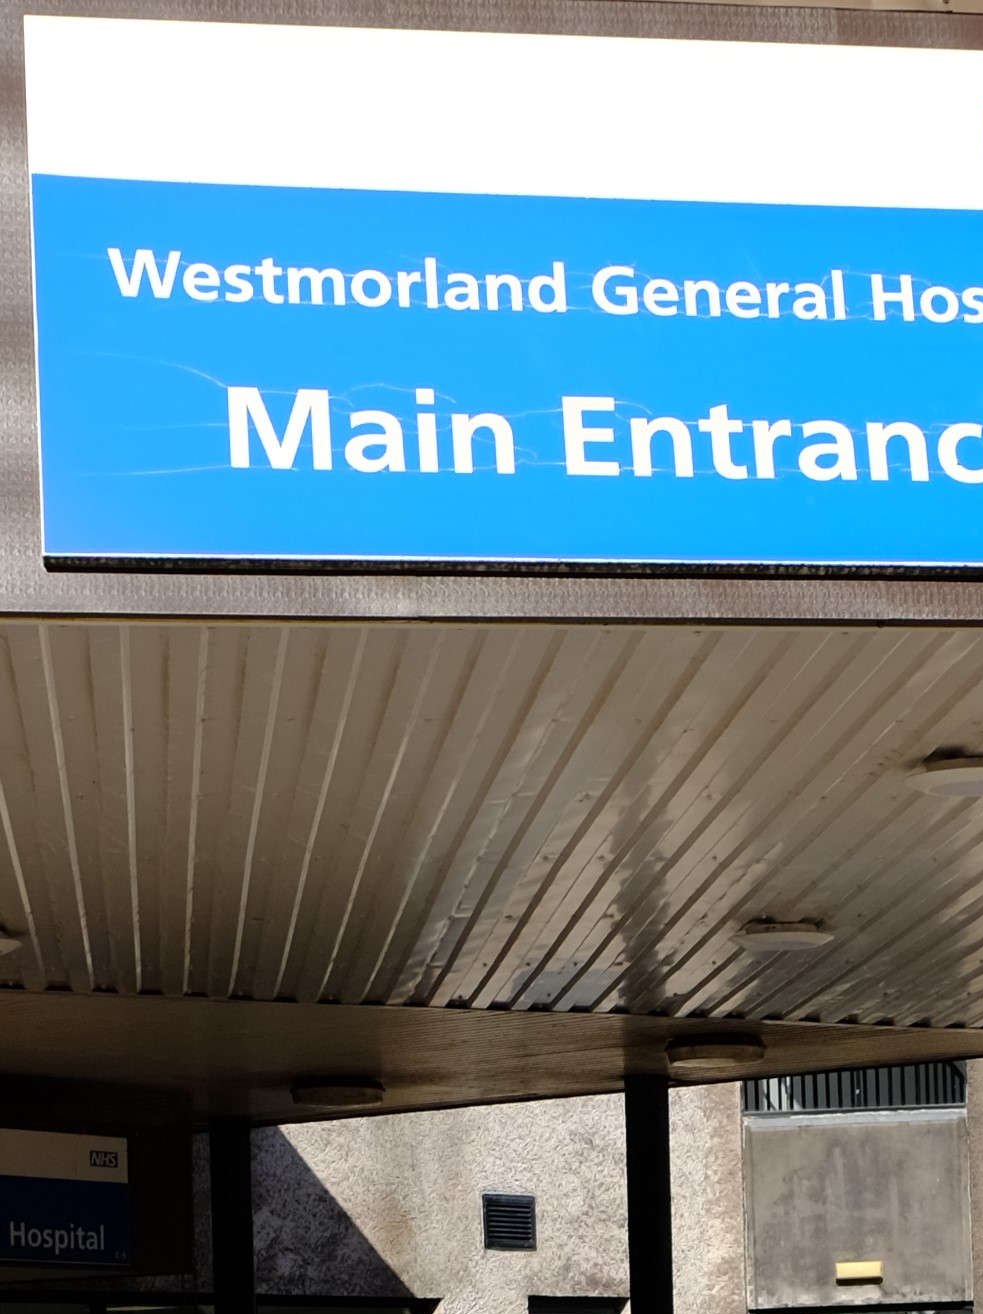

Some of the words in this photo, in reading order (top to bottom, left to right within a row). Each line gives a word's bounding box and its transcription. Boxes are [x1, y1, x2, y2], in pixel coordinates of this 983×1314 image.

[107, 247, 568, 314] Westmorland
[591, 264, 847, 321] General
[227, 386, 516, 475] Main
[90, 1151, 117, 1167] NHS
[9, 1220, 105, 1256] Hospital
